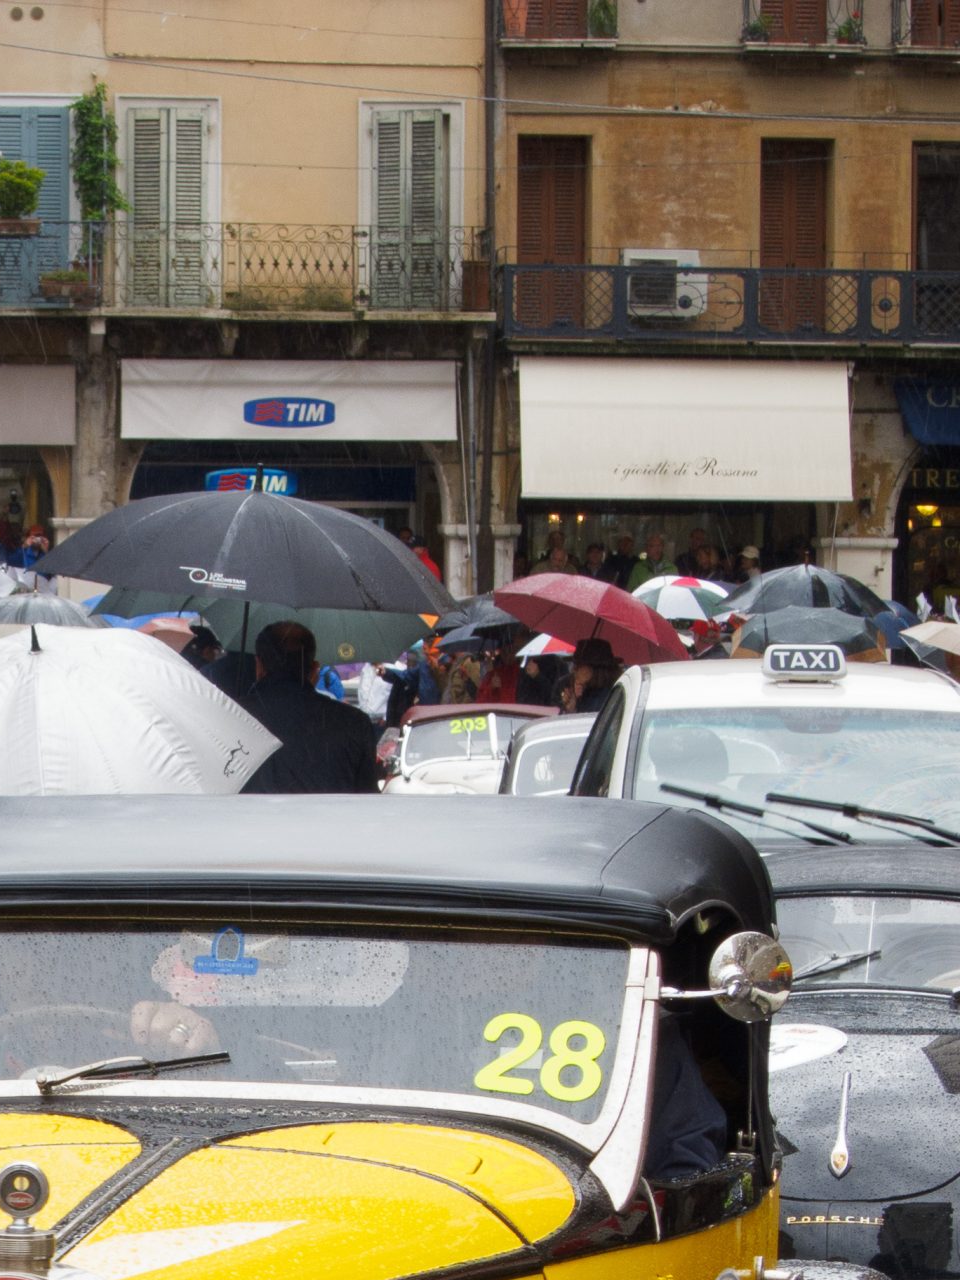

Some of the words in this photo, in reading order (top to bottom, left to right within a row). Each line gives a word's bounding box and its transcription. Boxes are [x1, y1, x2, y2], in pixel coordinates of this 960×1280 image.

[286, 402, 326, 422] TIM
[674, 462, 689, 477] di
[694, 455, 759, 477] Rossana
[772, 651, 836, 669] TAXI
[450, 716, 487, 734] 203
[474, 1012, 606, 1102] 28
